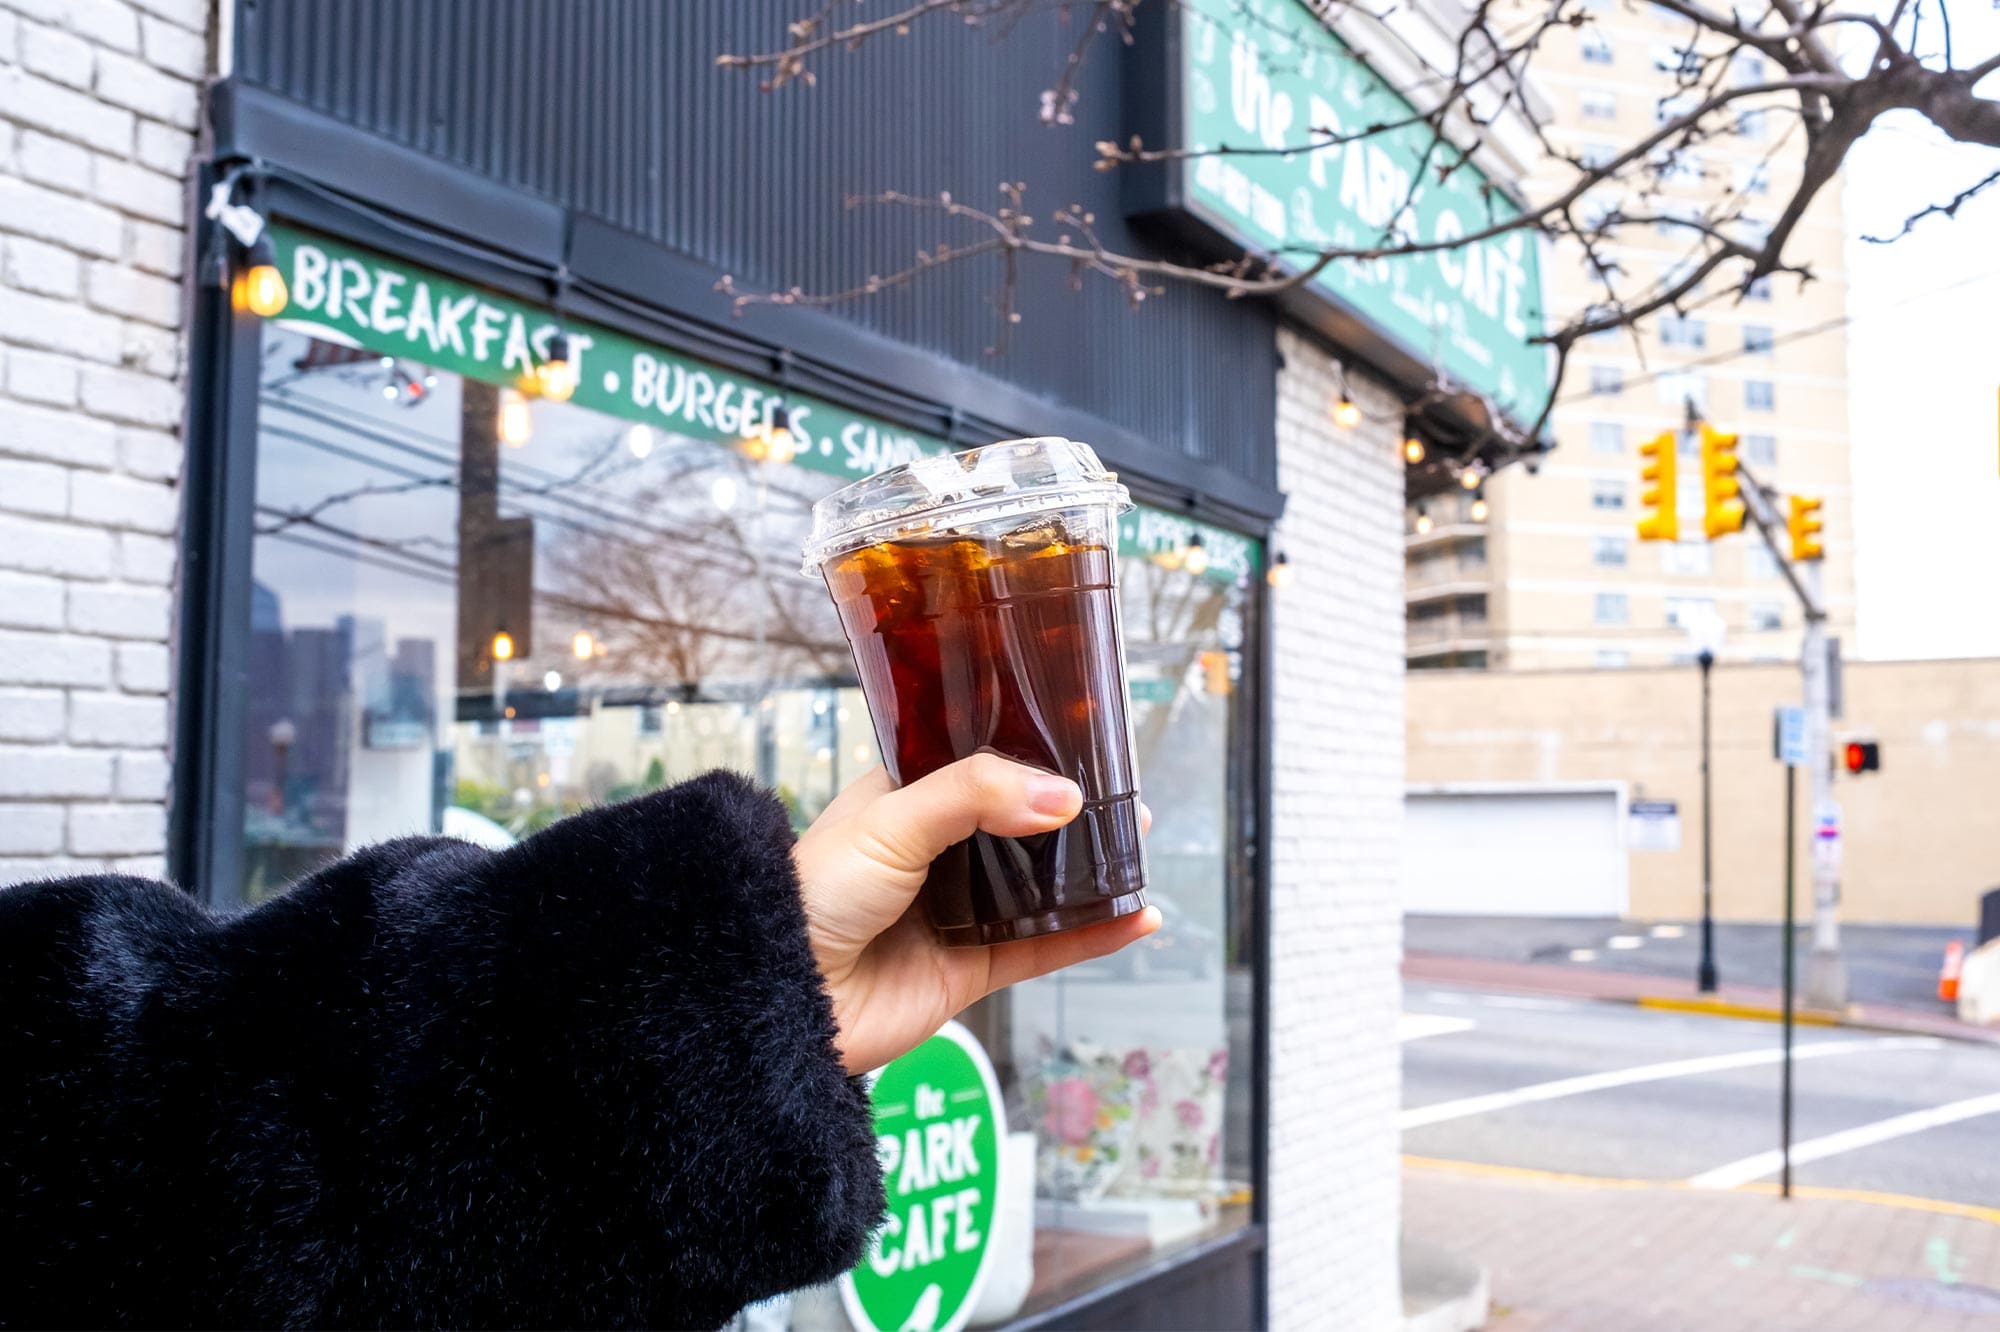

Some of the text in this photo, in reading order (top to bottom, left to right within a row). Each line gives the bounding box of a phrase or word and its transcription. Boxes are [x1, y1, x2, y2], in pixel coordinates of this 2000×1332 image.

[914, 1083, 946, 1120] the
[873, 1114, 982, 1196] PARK
[868, 1187, 982, 1278] CAFE
